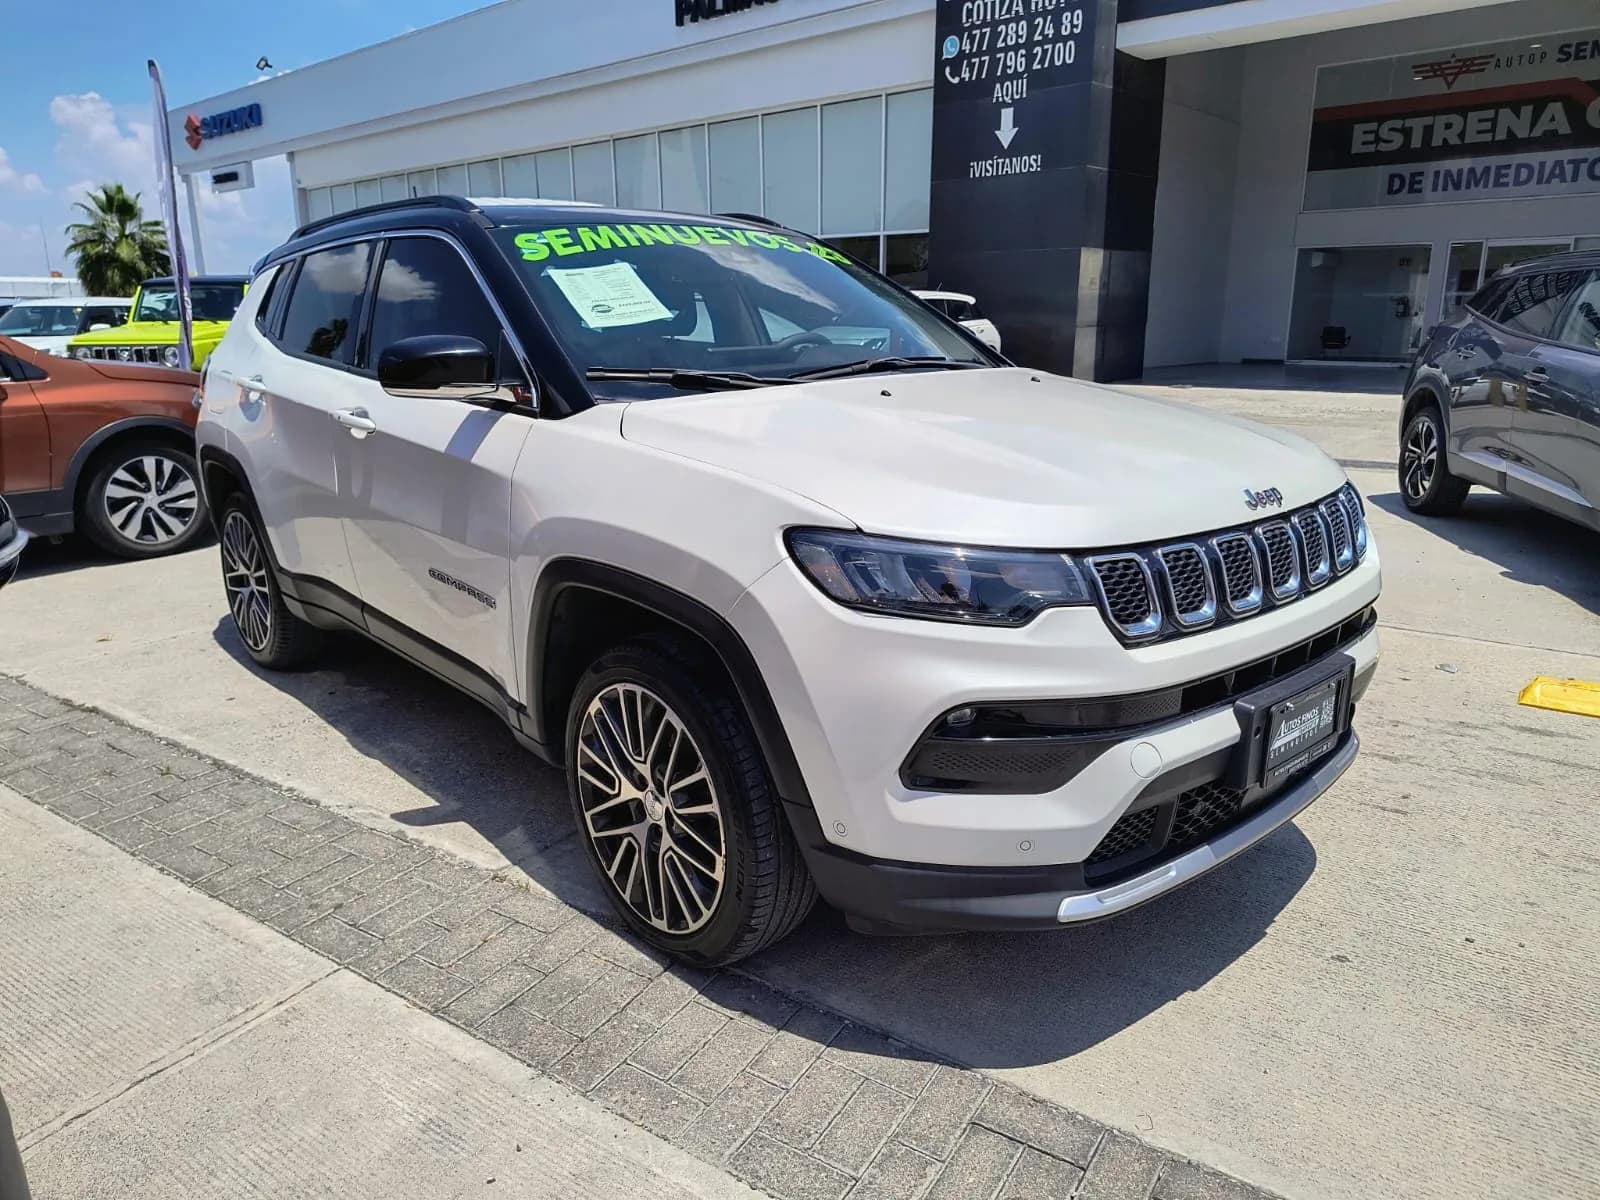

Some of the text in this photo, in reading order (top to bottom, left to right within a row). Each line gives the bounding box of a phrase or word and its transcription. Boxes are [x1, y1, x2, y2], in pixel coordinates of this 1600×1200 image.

[962, 0, 1024, 27] COTIZA
[962, 9, 1083, 53] 477 289 24 89
[961, 40, 1075, 82] 477 796 2700
[1494, 51, 1548, 70] AUTOP
[992, 73, 1028, 103] AQUÍ
[201, 103, 263, 140] SUZUKI
[1351, 101, 1572, 154] ESTRENA
[969, 154, 1042, 179] ¡VISÍTANOS!
[1387, 171, 1425, 196] DE
[514, 224, 803, 262] SEMINUEVOS
[1244, 486, 1283, 511] Jeep
